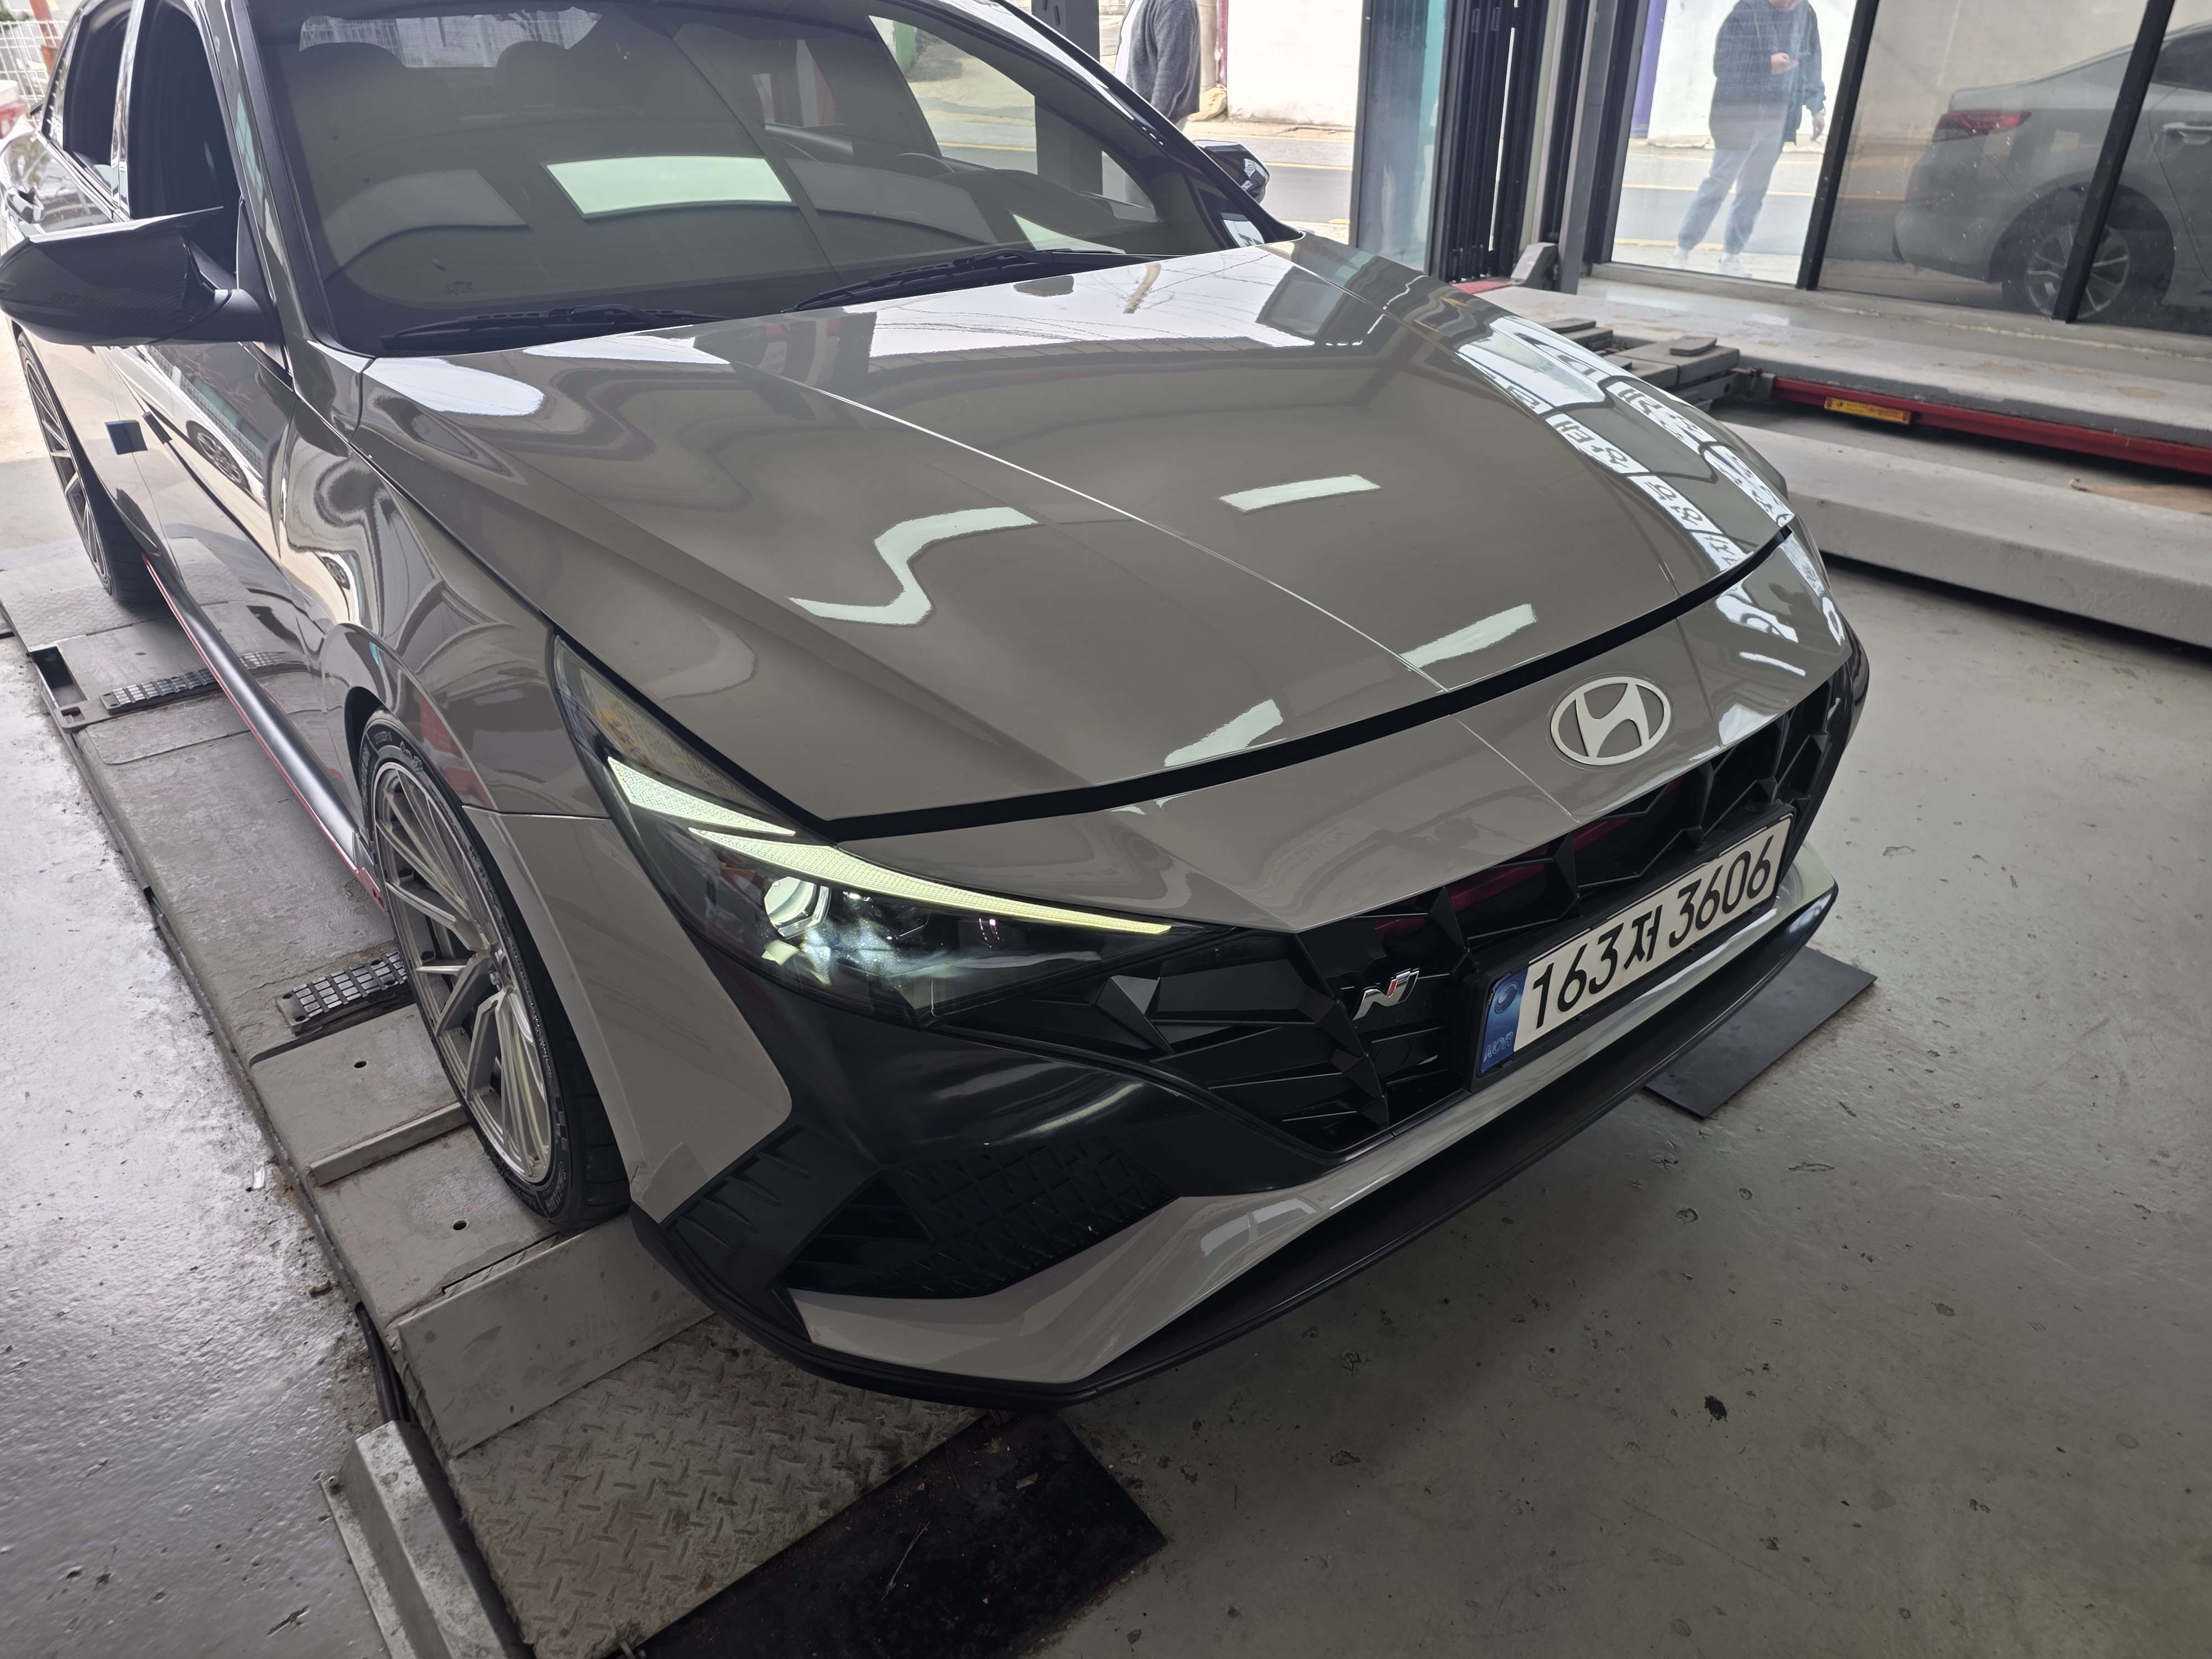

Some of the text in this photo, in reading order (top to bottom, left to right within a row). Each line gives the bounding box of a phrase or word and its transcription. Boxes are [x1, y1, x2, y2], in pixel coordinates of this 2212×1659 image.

[1532, 834, 1775, 1029] 163저 3606
[1483, 1031, 1514, 1062] KOR
